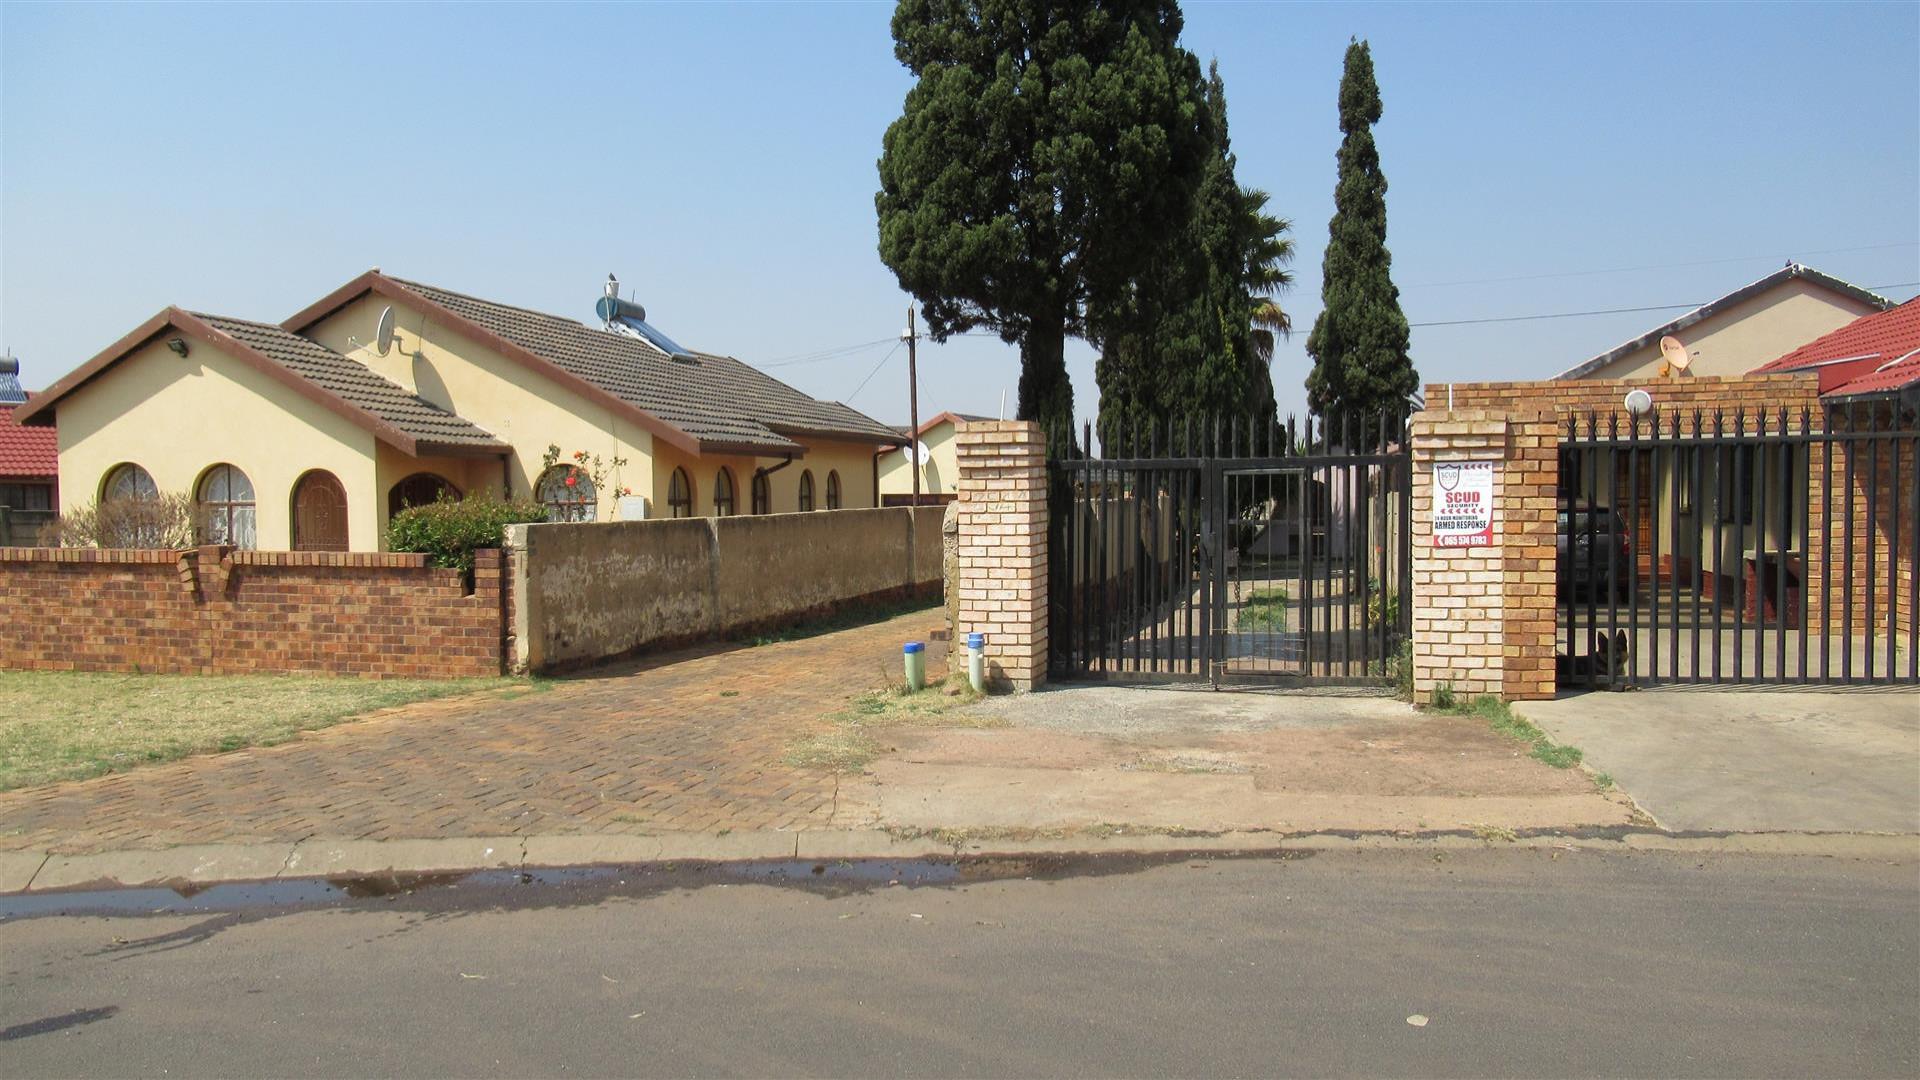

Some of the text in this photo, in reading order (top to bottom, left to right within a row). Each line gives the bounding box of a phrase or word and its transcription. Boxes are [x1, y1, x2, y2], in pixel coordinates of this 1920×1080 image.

[1441, 471, 1457, 479] SCUD
[1445, 491, 1480, 503] SCUD
[1435, 520, 1487, 529] ARMED RESPONSE
